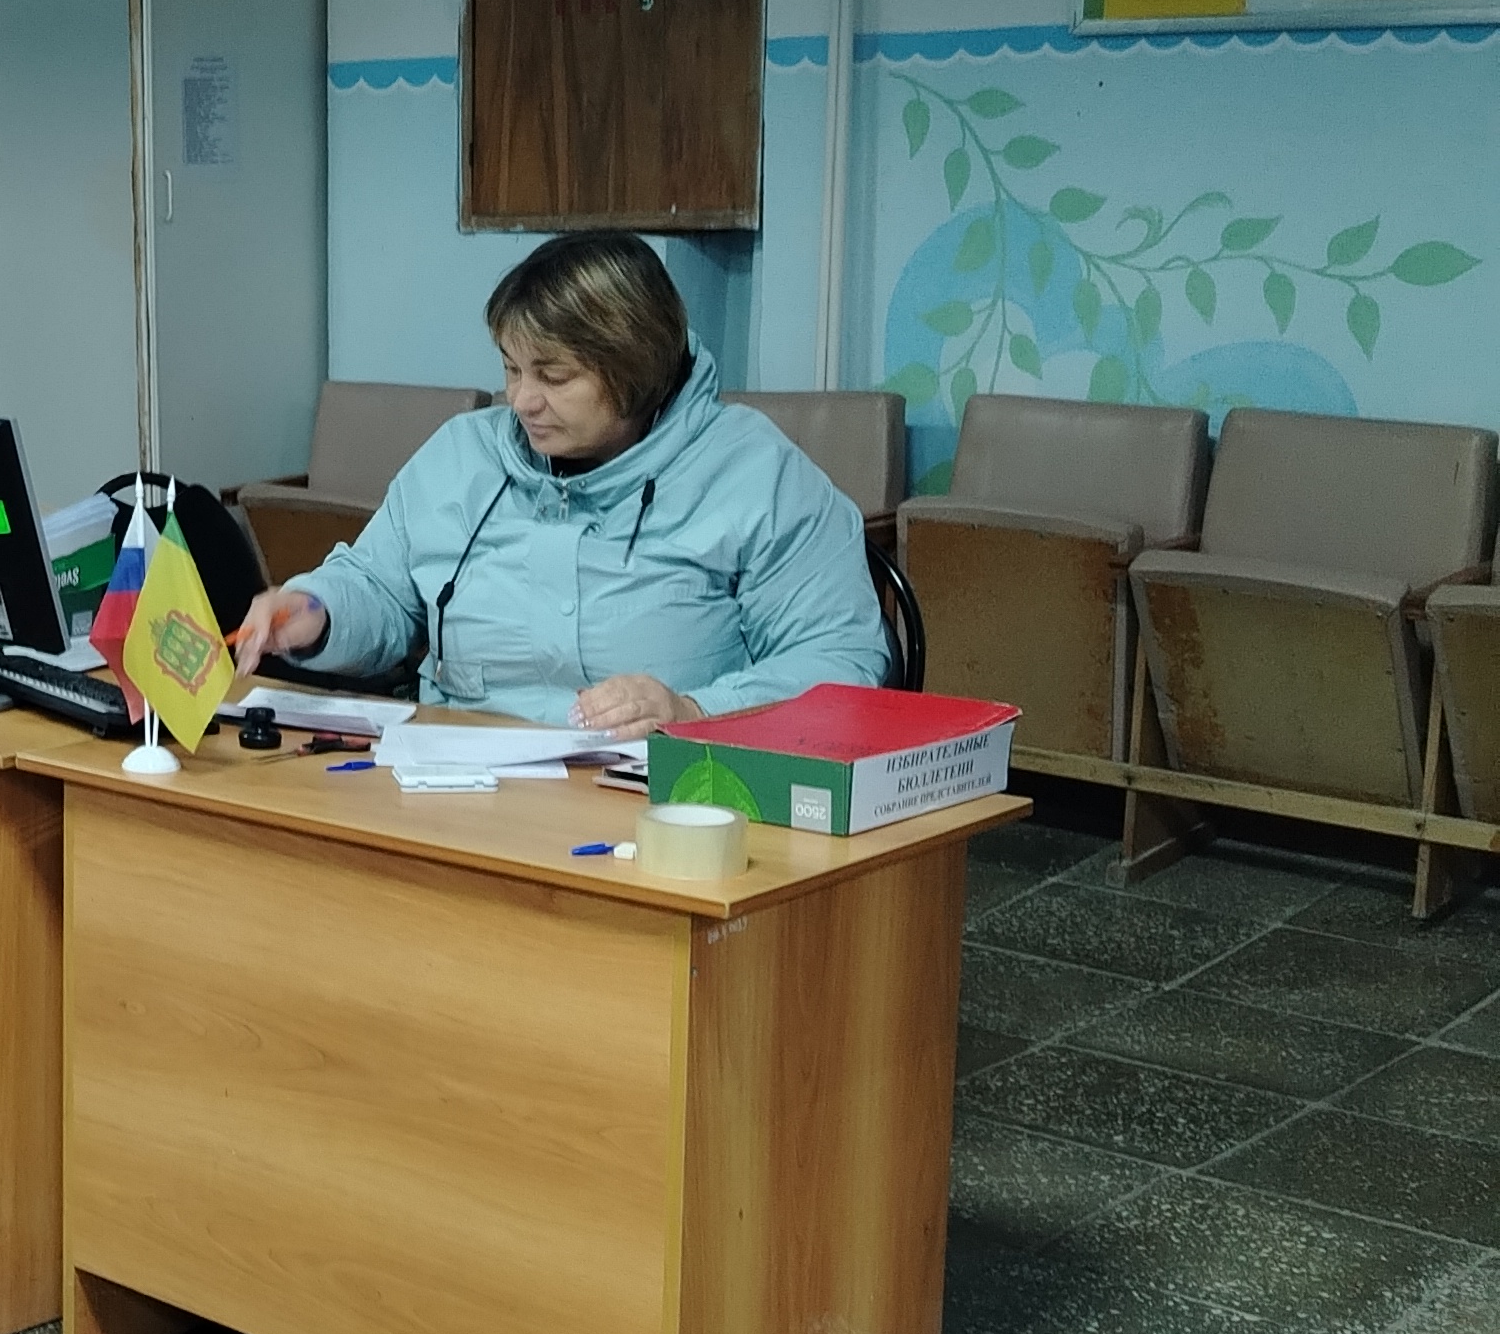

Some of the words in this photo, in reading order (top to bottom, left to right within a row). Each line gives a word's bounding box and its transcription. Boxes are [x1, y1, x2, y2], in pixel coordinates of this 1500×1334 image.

[53, 566, 80, 592] Svet
[885, 733, 991, 774] ИЗБИРАТЕЛЬНЫЕ
[897, 759, 974, 794] БЮЛЛЕТЕНИ
[795, 803, 827, 820] 2500
[874, 795, 918, 818] СОБРАНИЕ
[920, 773, 992, 805] ПРЕДСТАВИТЕЛЕЙ
